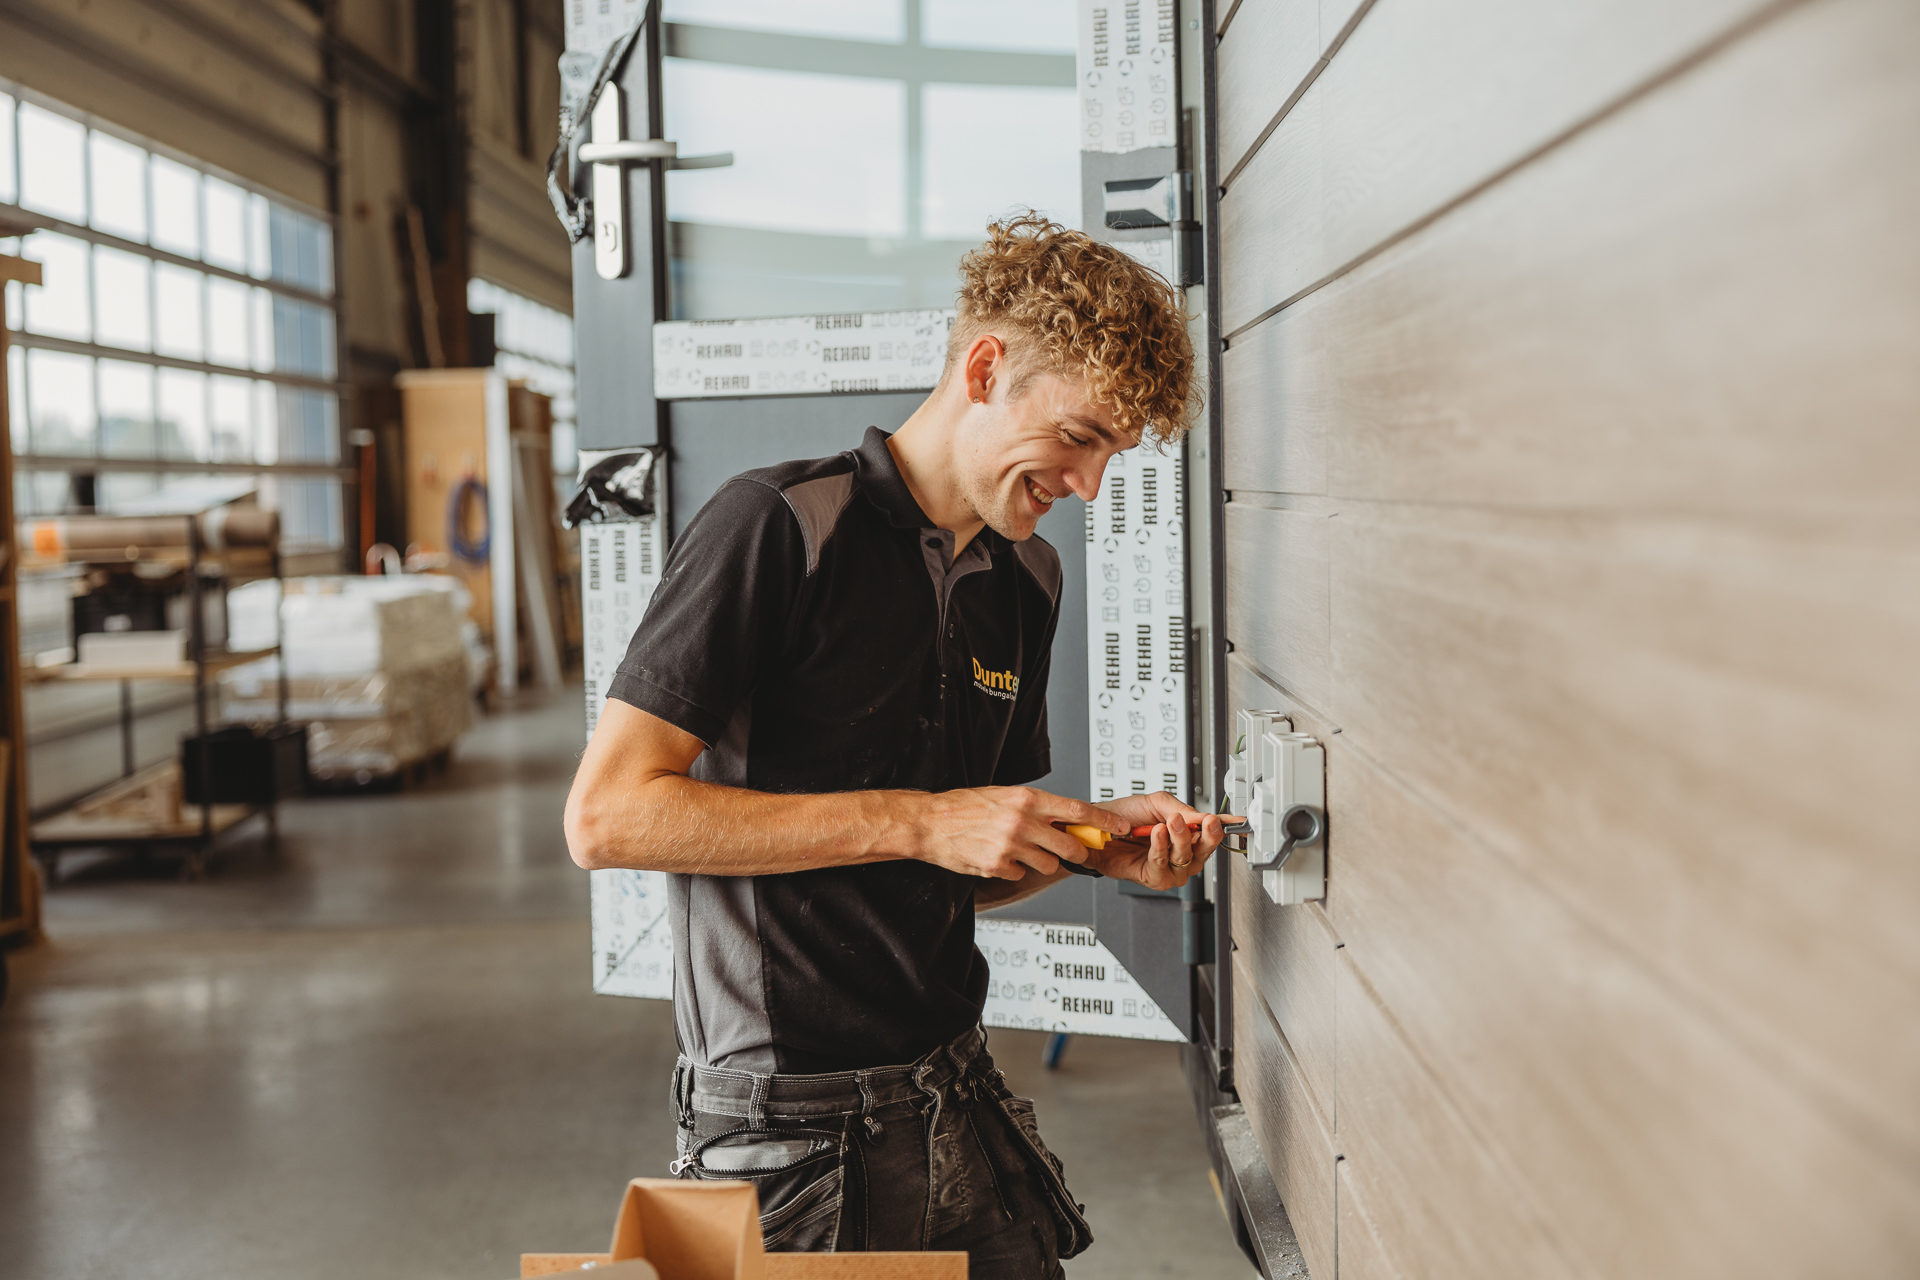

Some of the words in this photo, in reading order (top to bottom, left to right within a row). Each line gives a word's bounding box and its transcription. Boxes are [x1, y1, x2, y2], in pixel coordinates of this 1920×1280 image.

[1093, 8, 1108, 67] REHAU
[1157, 0, 1174, 43] REHA
[697, 344, 742, 359] REHAU
[823, 346, 870, 362] REHAU
[704, 375, 750, 390] REHAU
[1110, 477, 1126, 534] REHAU
[1142, 467, 1157, 525] REHAU
[589, 538, 600, 590] REHAU
[614, 530, 626, 582] REHAU
[1105, 633, 1120, 689] REHAU
[1137, 624, 1152, 681] REHAU
[1169, 616, 1184, 673] REHAU
[1046, 929, 1097, 947] REHAU
[1054, 963, 1106, 981] REHAU
[1062, 997, 1114, 1015] REHAU
